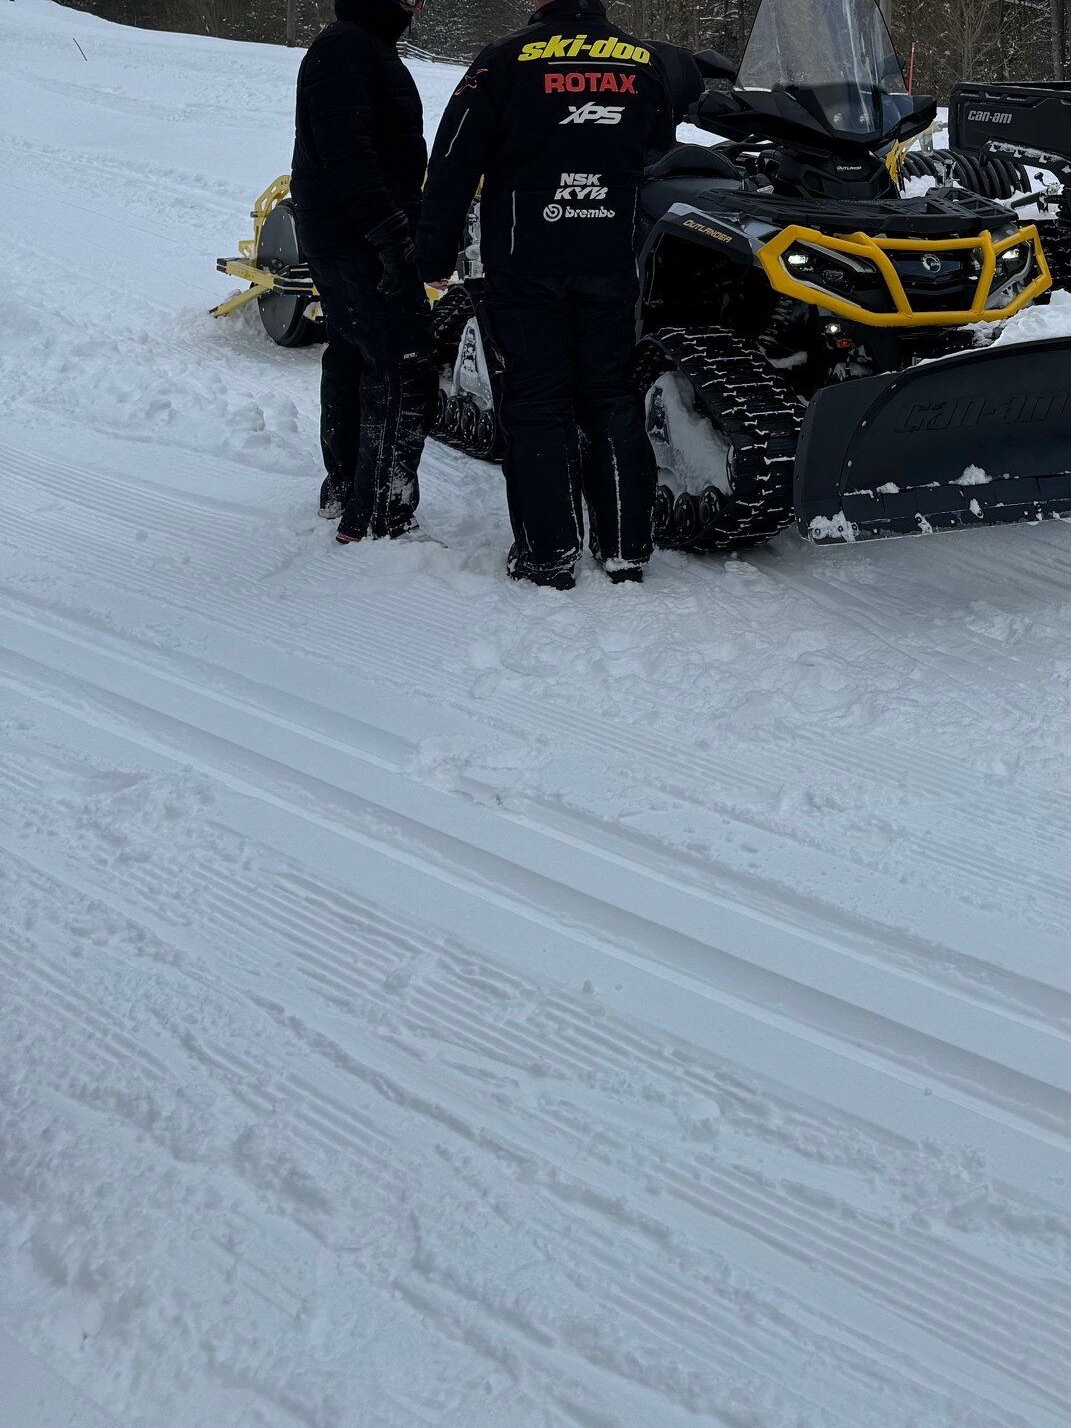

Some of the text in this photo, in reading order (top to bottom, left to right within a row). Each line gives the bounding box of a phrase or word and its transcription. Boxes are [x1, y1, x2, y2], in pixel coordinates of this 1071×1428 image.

[518, 34, 650, 64] ski-doo
[544, 73, 636, 93] ROTAX
[558, 101, 626, 125] XPS
[967, 110, 1013, 124] can-am
[560, 173, 602, 186] NSK
[554, 186, 609, 200] KYB
[565, 206, 616, 218] brembo
[682, 219, 733, 243] OUTLANDER
